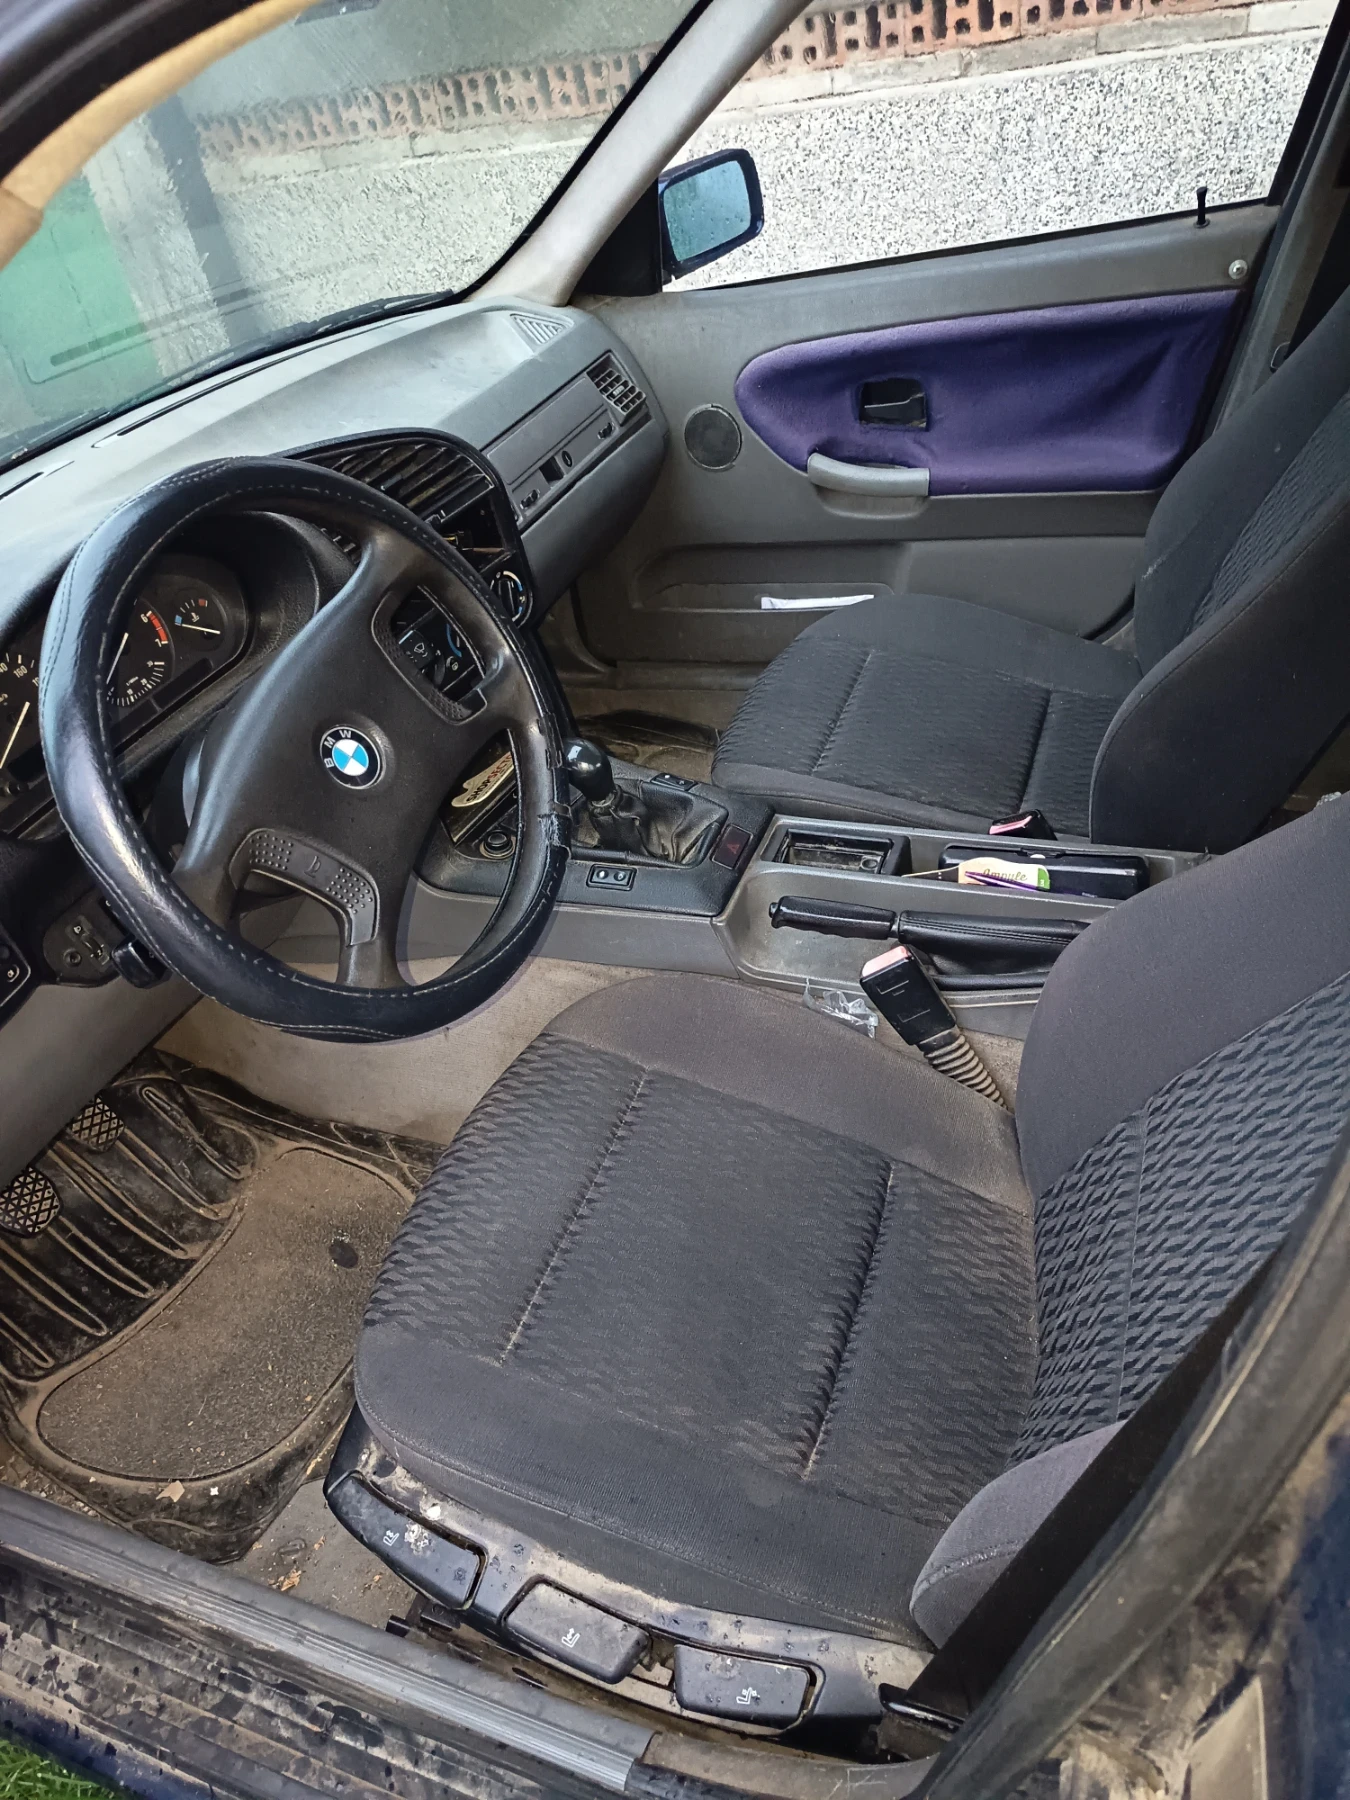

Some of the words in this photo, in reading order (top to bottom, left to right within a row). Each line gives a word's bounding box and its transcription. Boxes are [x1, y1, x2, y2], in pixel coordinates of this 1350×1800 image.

[140, 613, 148, 623] 6
[154, 638, 162, 648] 7
[323, 729, 352, 768] BMW
